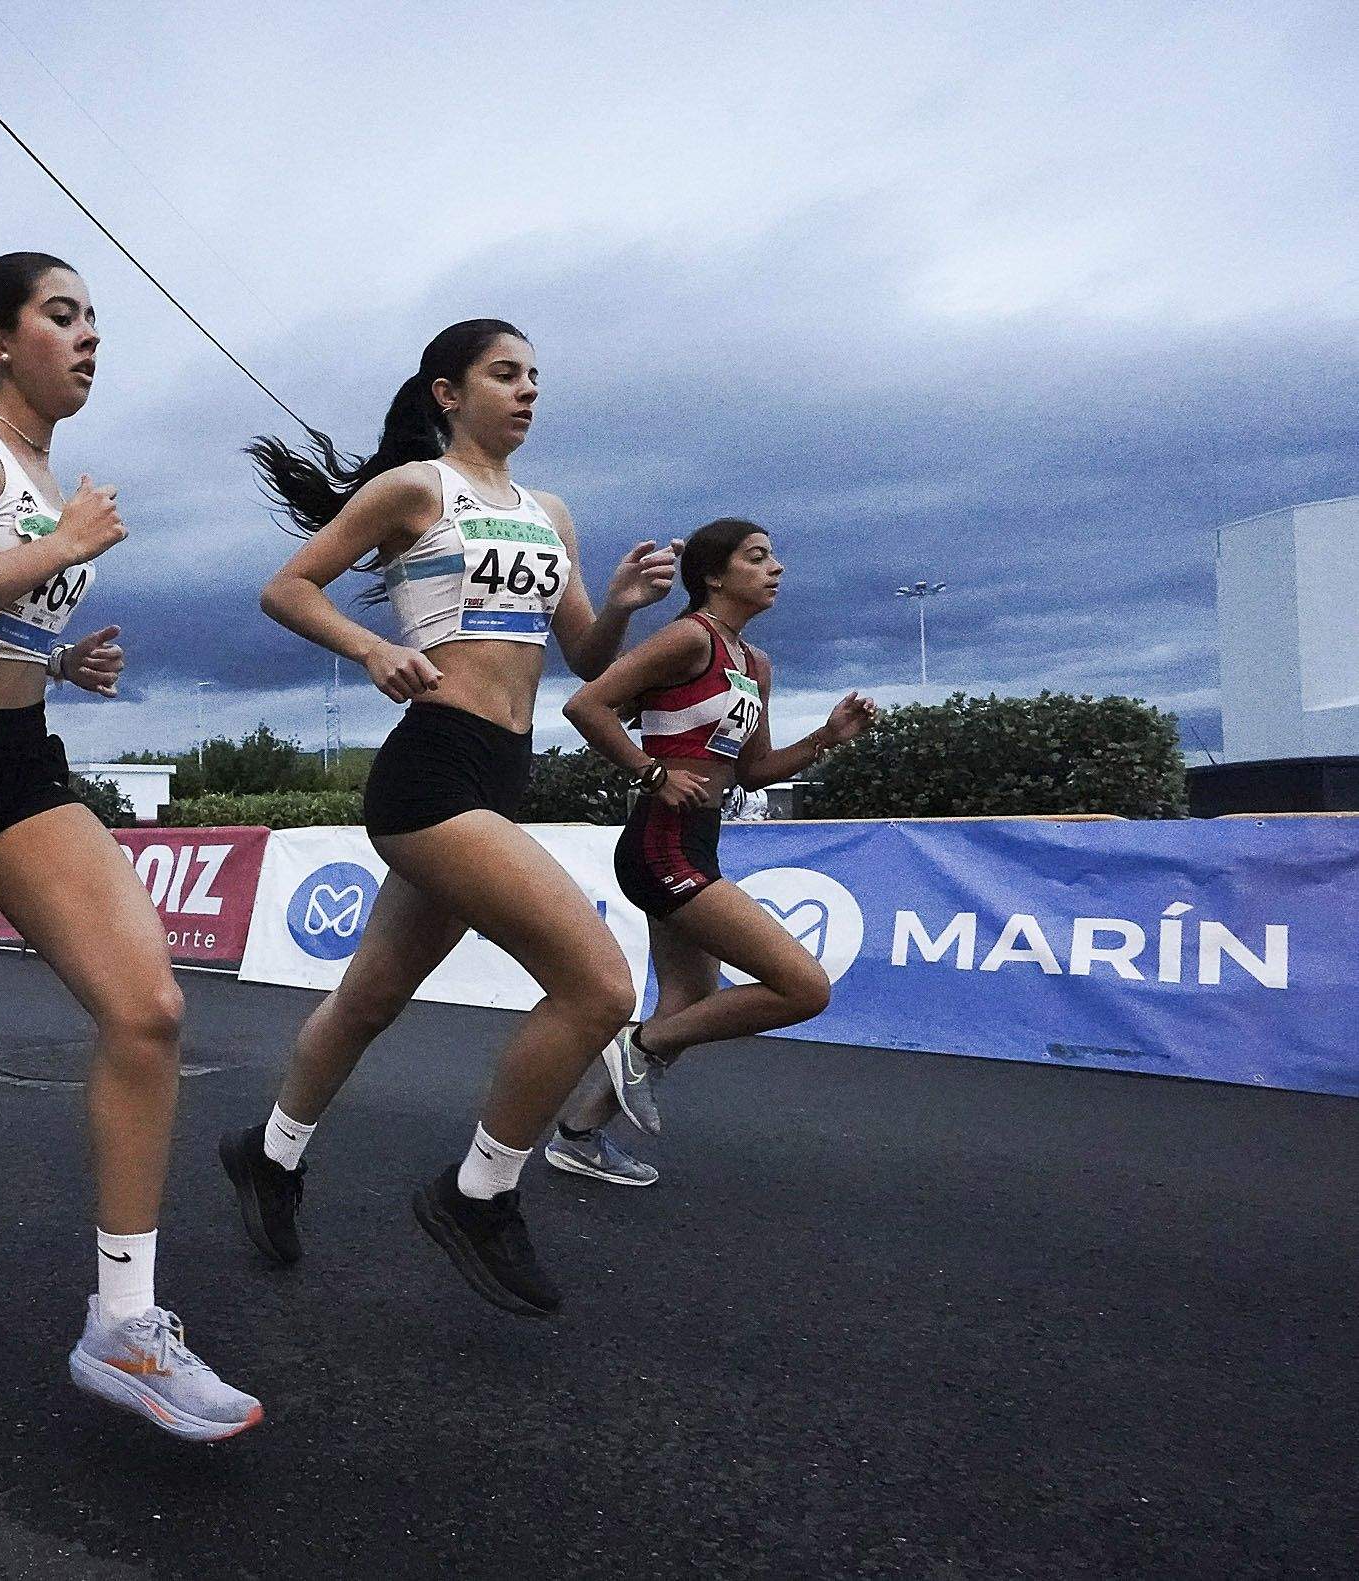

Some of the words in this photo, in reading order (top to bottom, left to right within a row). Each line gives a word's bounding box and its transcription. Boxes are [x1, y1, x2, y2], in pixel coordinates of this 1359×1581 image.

[471, 548, 560, 598] 463
[119, 844, 234, 915] OIZ
[891, 901, 1289, 990] MARÍN
